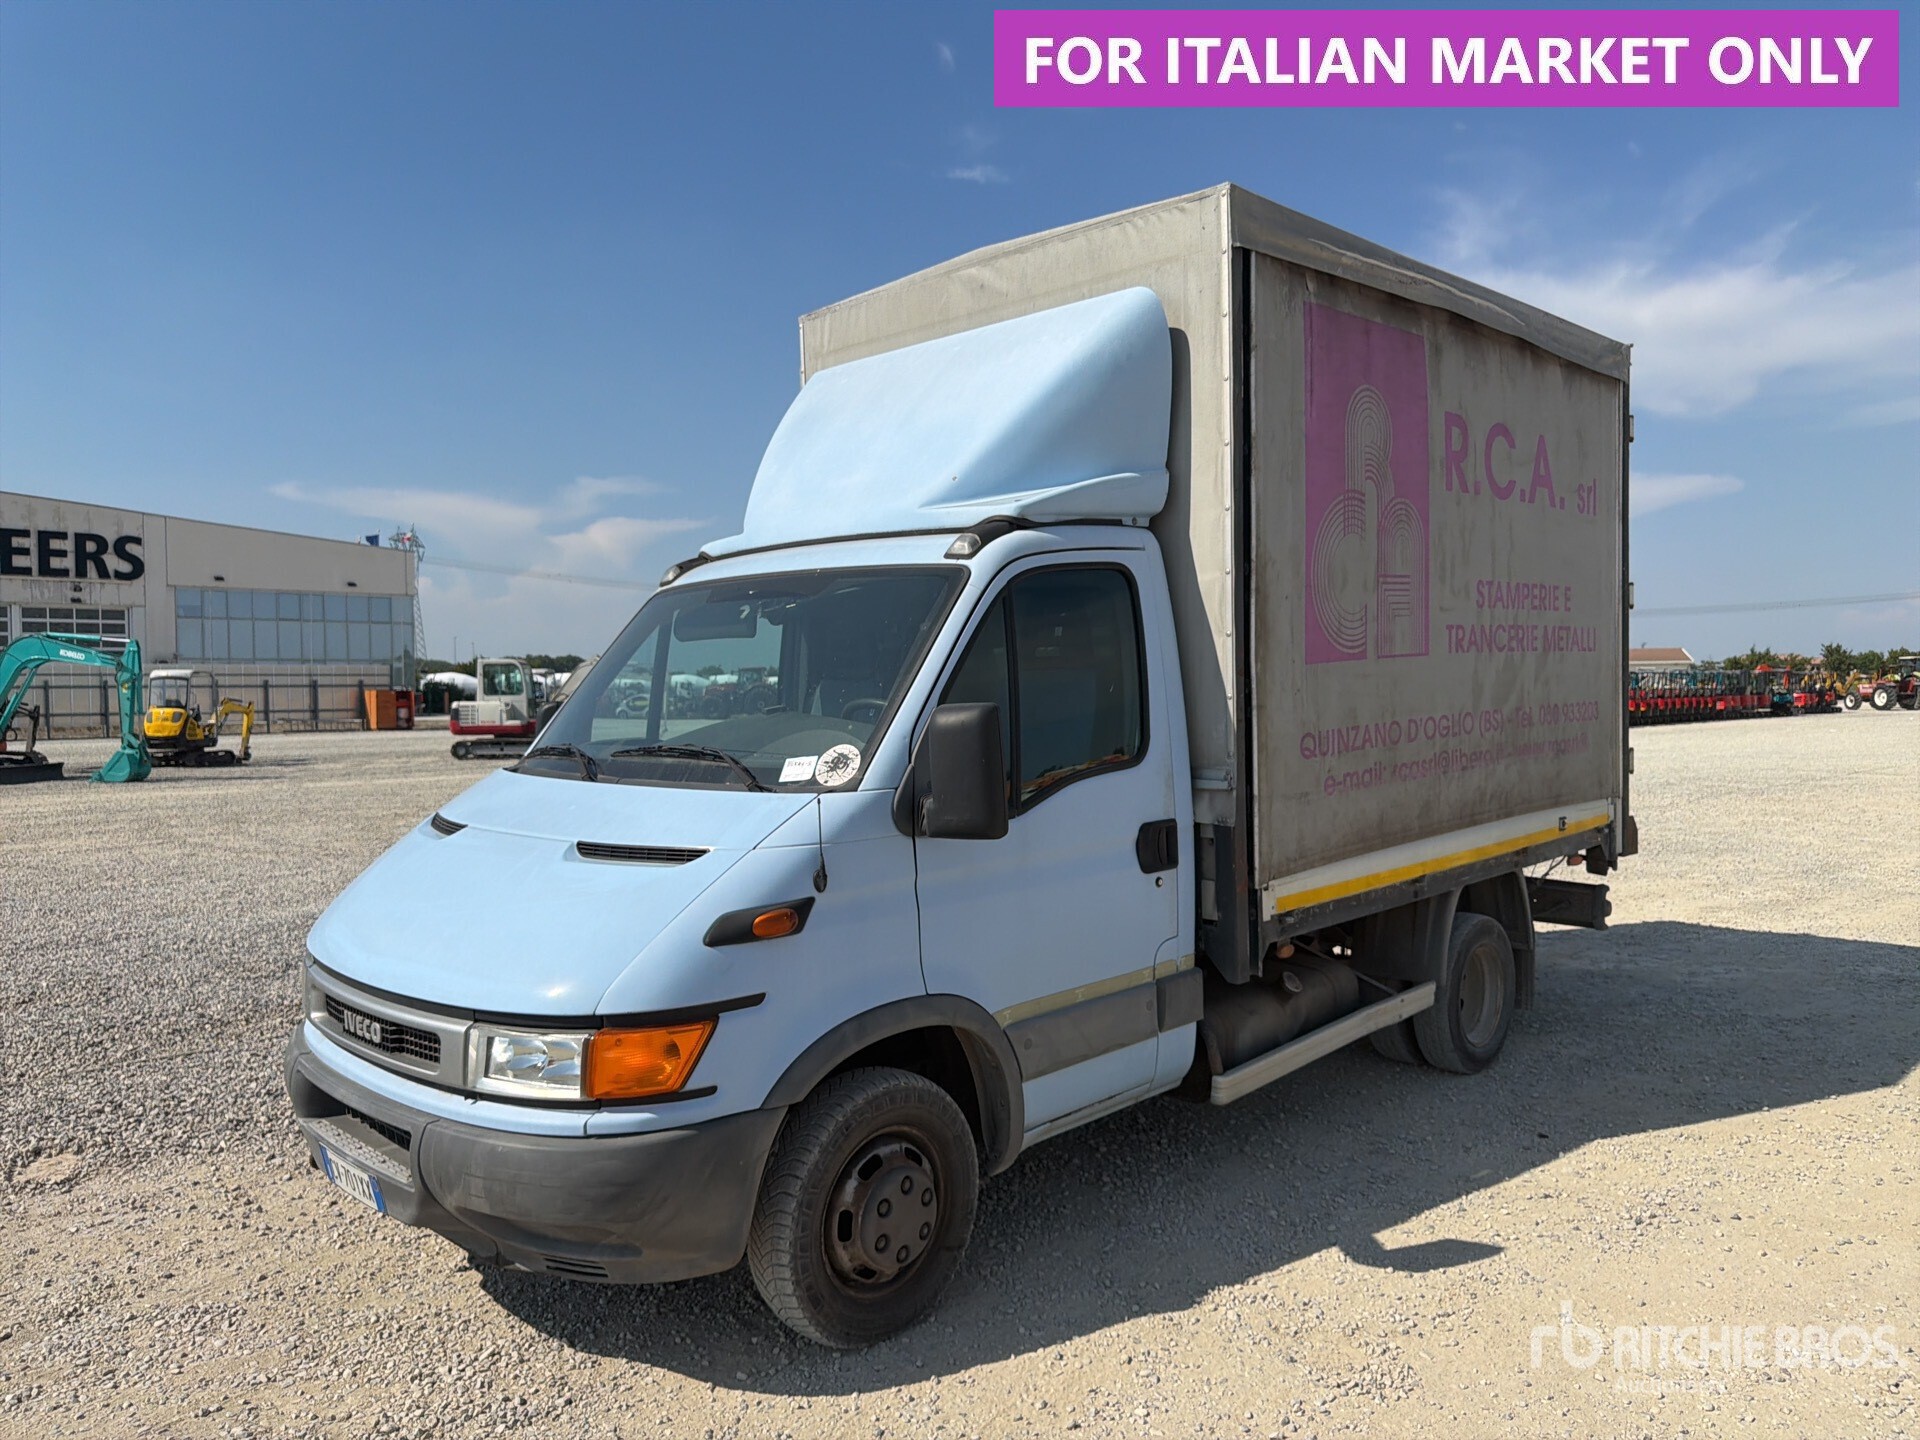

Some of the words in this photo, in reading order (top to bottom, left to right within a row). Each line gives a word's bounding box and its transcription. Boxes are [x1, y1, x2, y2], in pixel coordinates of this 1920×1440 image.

[1444, 411, 1566, 510] R.C.A.
[0, 527, 145, 581] EERS
[1476, 579, 1560, 612] STAMPERIE
[1563, 586, 1572, 612] E
[1446, 624, 1539, 654] TRANCERIE
[1543, 625, 1597, 653] METALLI
[1300, 720, 1402, 760] QUINZANO
[1407, 711, 1474, 744] D'OGLIO
[343, 1009, 382, 1044] IVECO
